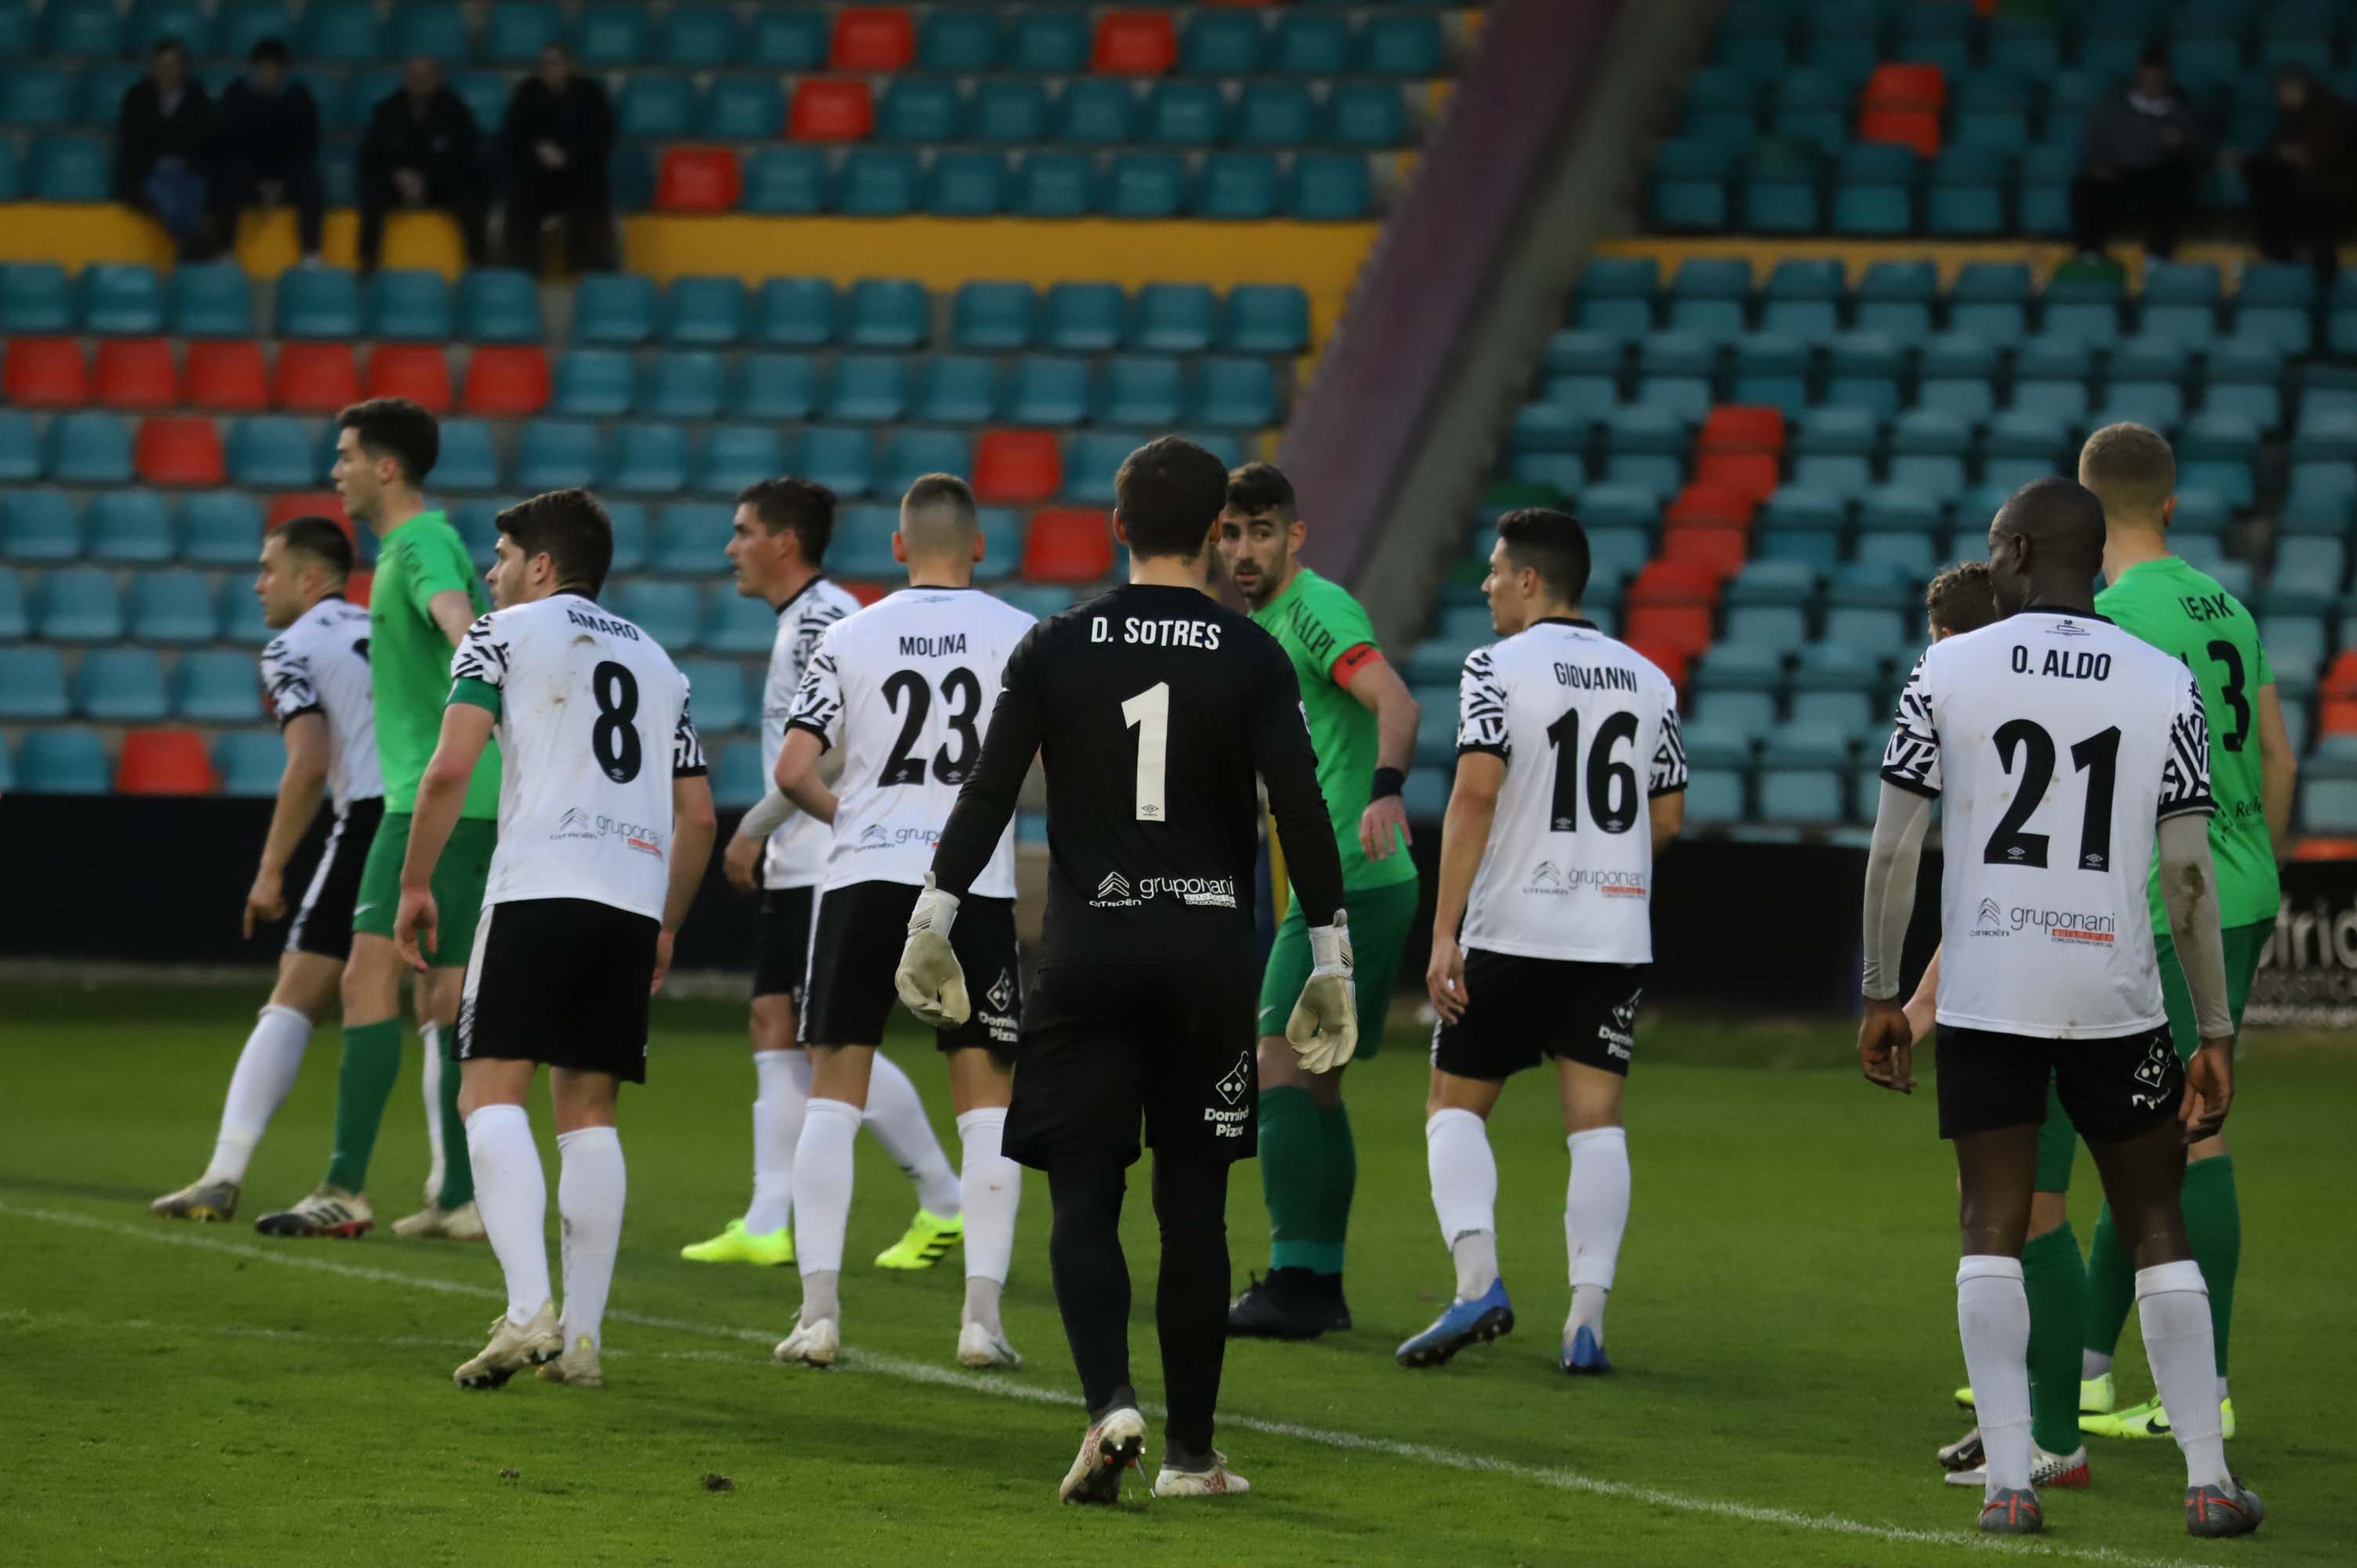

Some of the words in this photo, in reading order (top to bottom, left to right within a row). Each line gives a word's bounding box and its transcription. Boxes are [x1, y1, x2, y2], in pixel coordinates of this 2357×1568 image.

[2179, 593, 2234, 622] LEAK
[566, 609, 640, 642] AMARO
[1091, 616, 1113, 643] D.
[1124, 617, 1222, 651] SOTRES
[899, 633, 967, 657] MOLINA
[2011, 644, 2034, 673] O.
[2041, 649, 2112, 681] ALDO
[1553, 662, 1638, 693] GIOVANNI
[2181, 640, 2250, 751] 3
[593, 661, 641, 784] 8
[877, 666, 982, 788] 23
[1121, 681, 1169, 822] 1
[1546, 707, 1640, 834] 16
[1983, 718, 2122, 873] 21
[895, 827, 942, 845] grup
[1139, 875, 1234, 899] gruponani
[2010, 906, 2115, 935] gruponani
